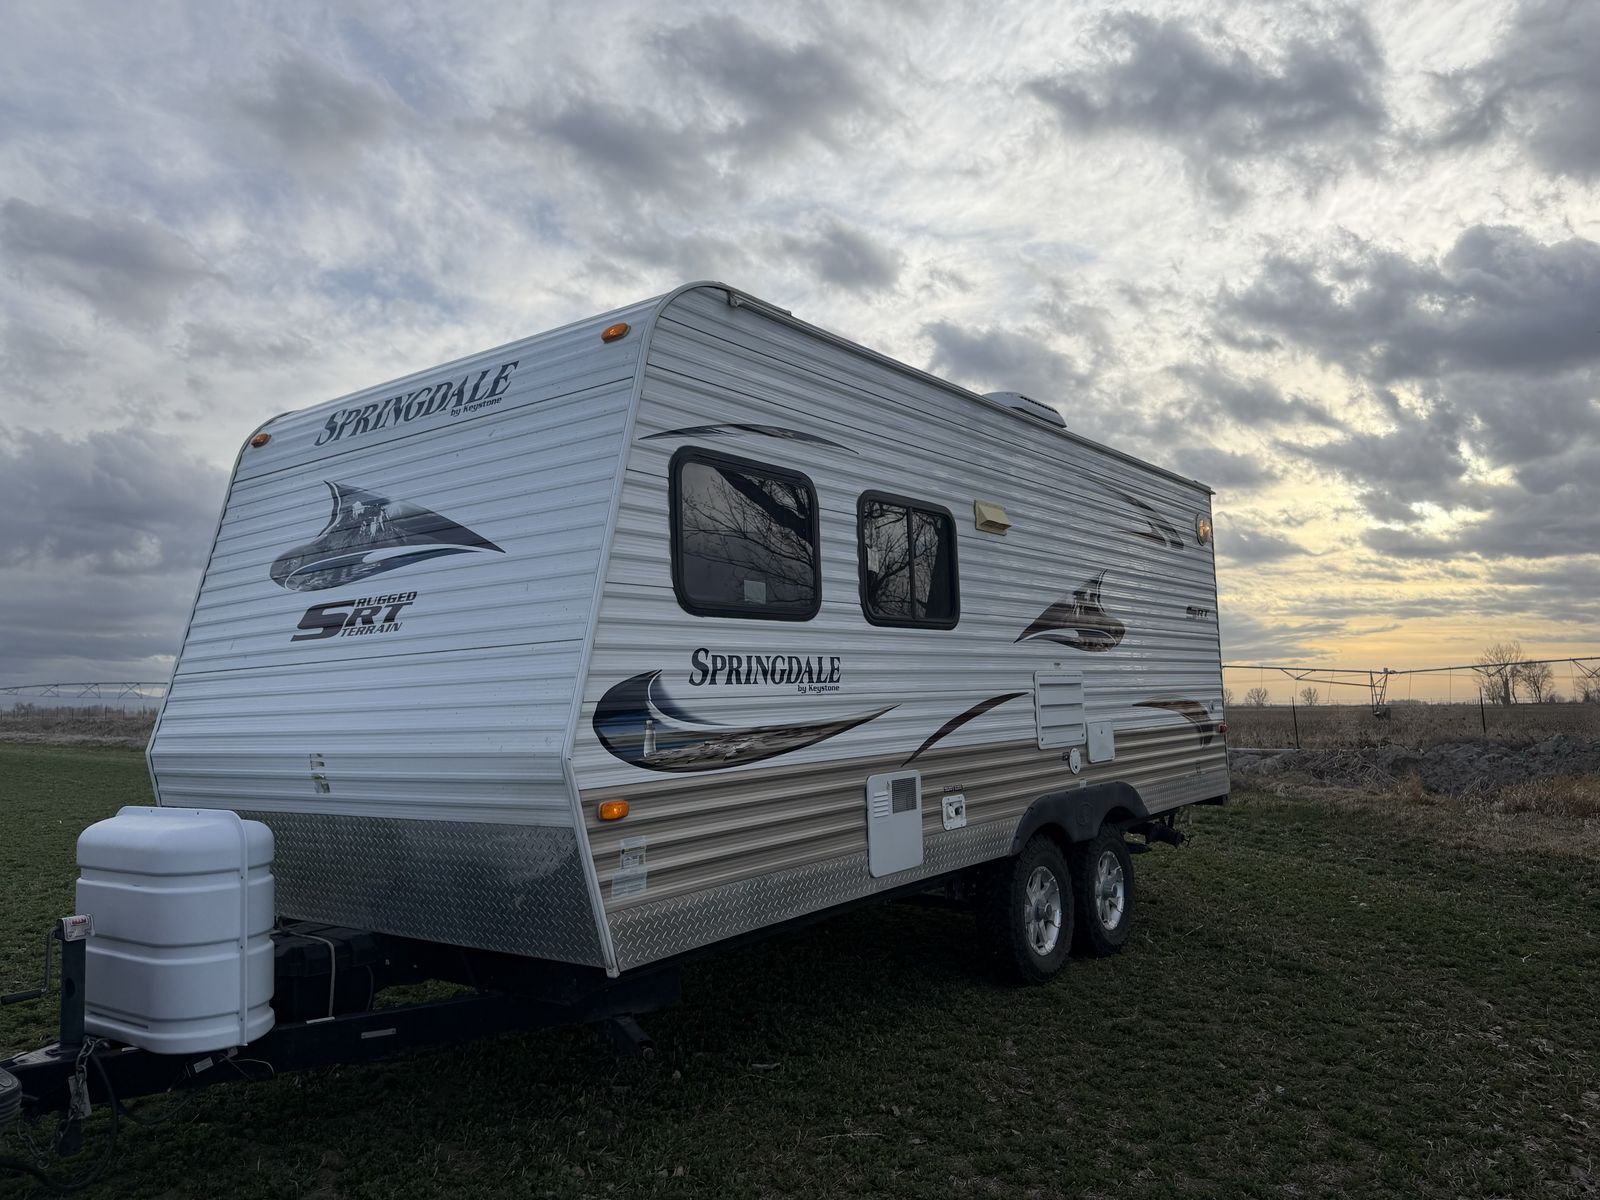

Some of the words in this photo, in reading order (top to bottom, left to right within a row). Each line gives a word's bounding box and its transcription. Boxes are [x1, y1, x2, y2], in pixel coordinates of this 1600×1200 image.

[313, 360, 520, 447] SPRINGDALE
[450, 407, 462, 417] by
[463, 397, 502, 413] Keystone
[355, 591, 418, 608] RUGGED
[290, 599, 414, 642] SRT
[340, 622, 403, 637] TERRAIN
[688, 647, 842, 687] SPRINGDALE
[797, 684, 807, 694] by
[808, 684, 840, 694] Keystone
